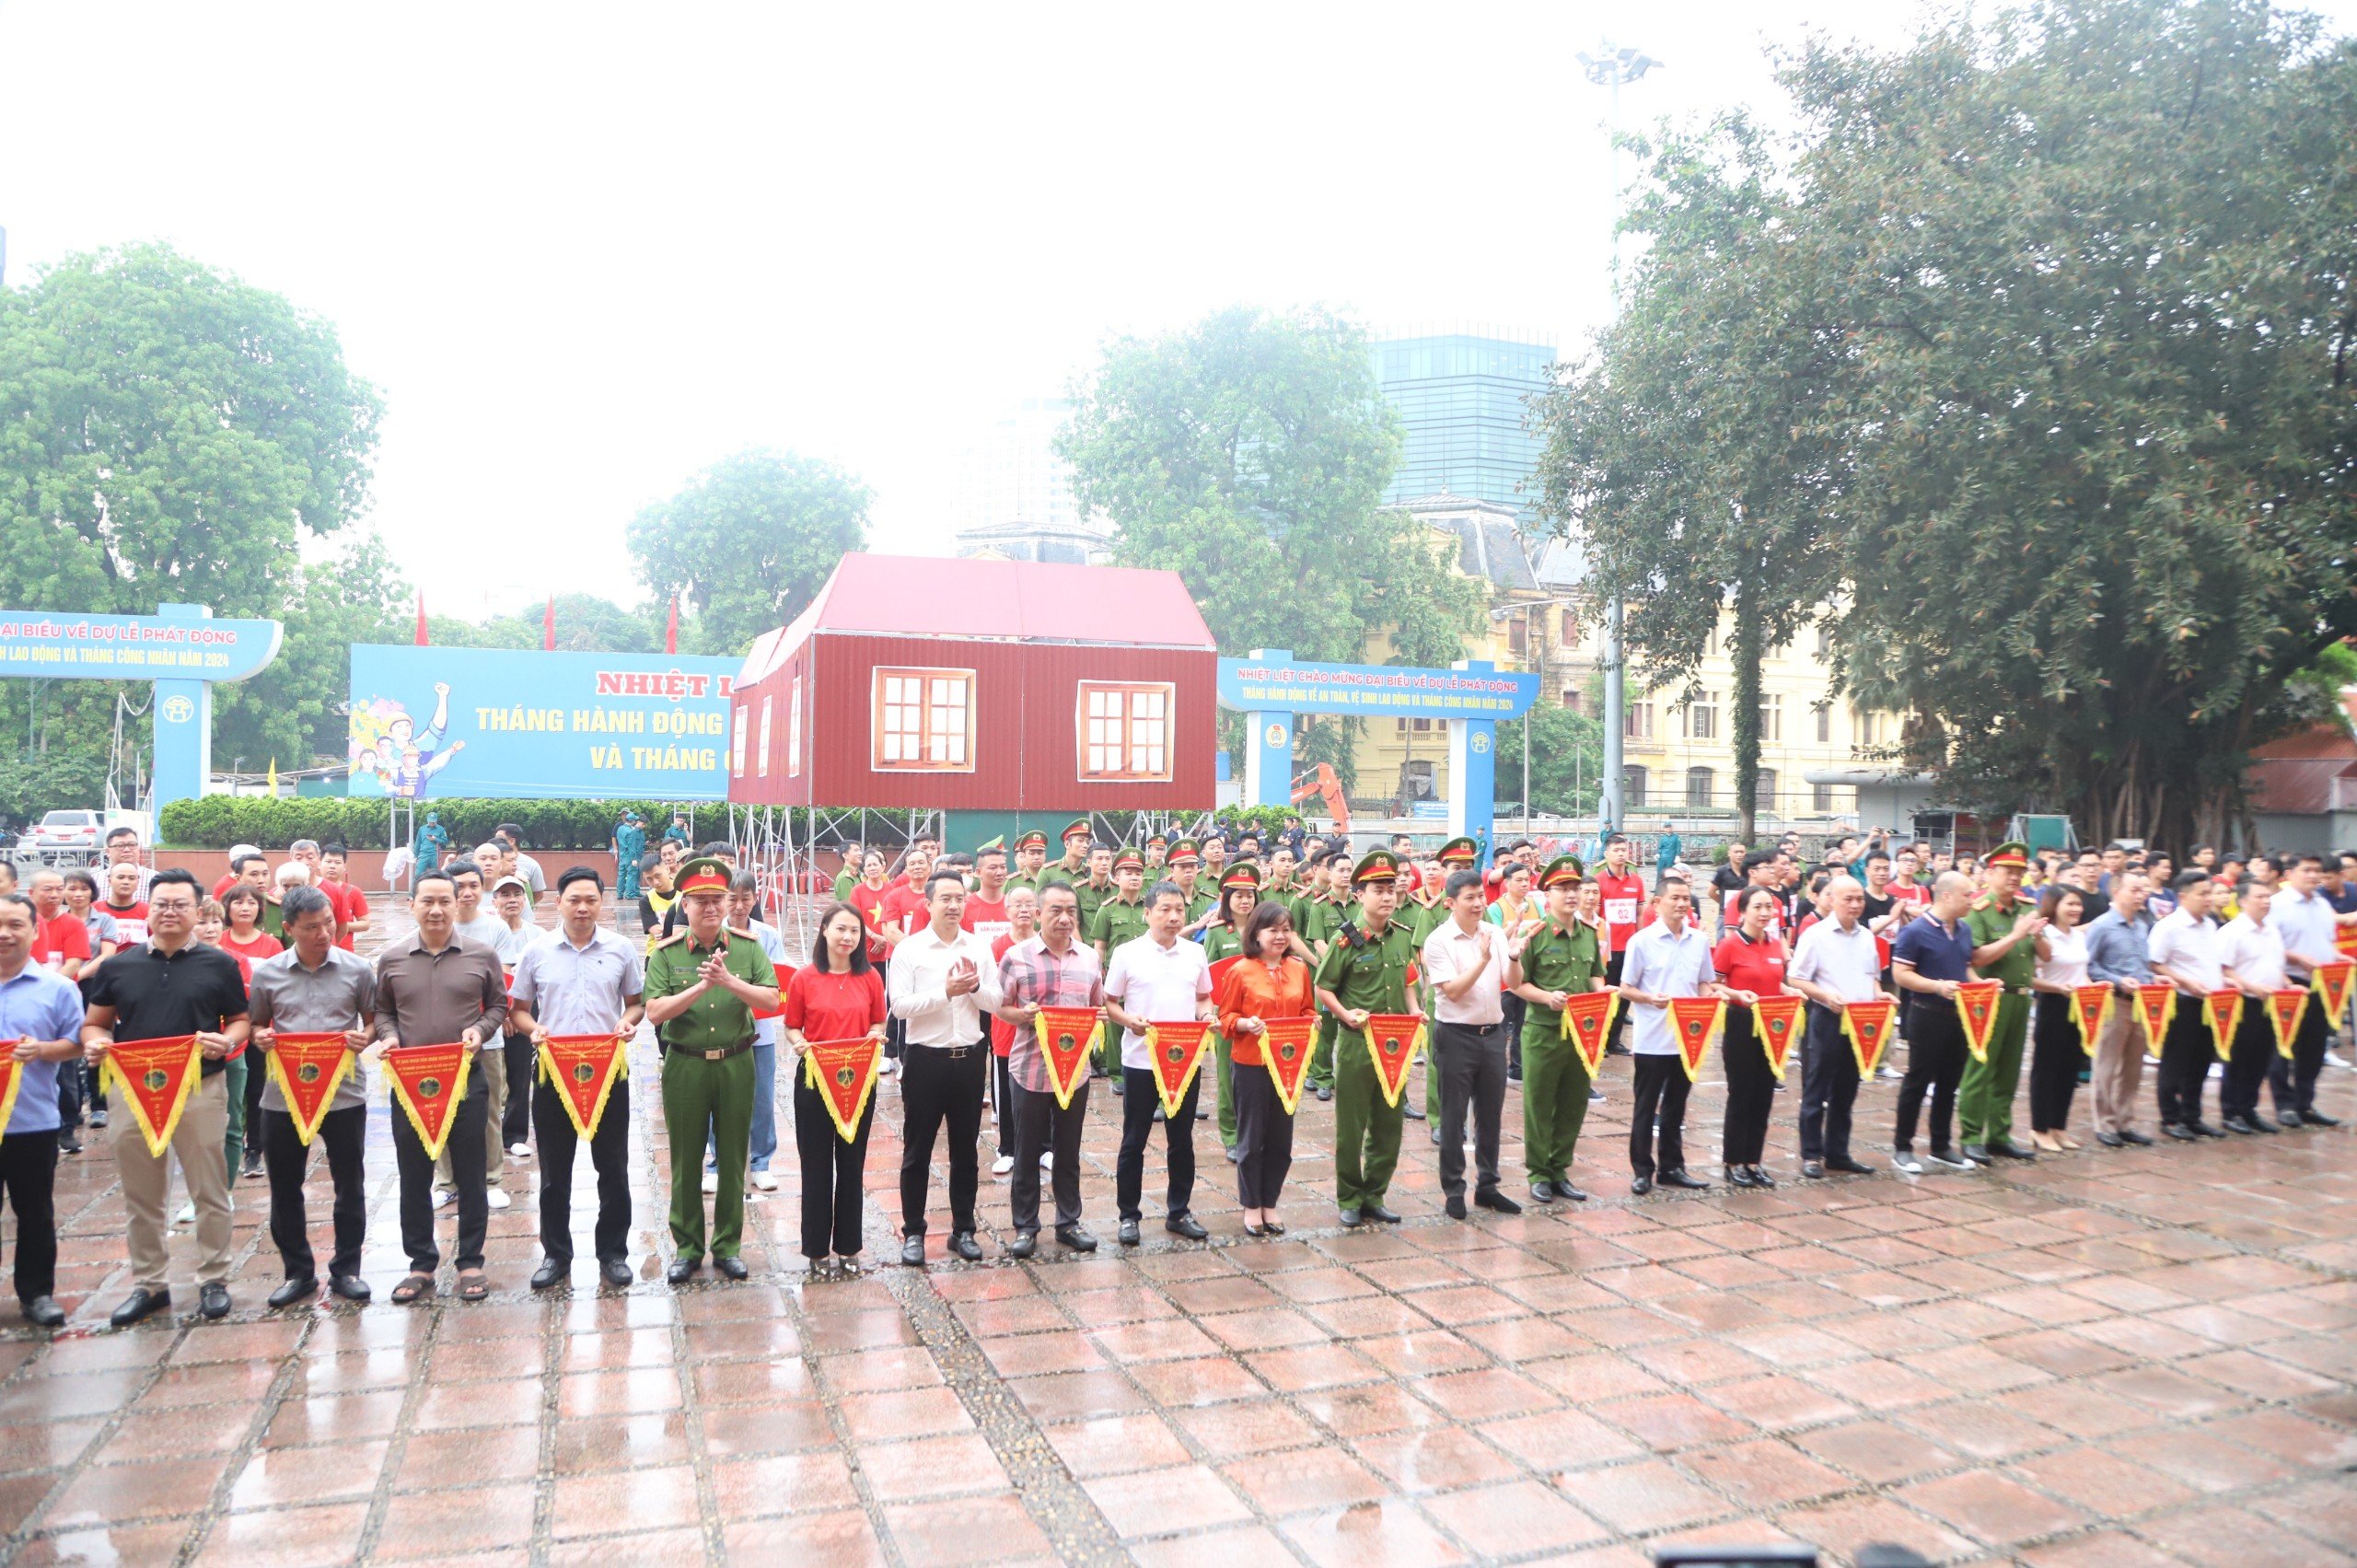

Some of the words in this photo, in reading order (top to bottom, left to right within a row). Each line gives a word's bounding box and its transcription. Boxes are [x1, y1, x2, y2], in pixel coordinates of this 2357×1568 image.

[23, 620, 62, 637] BIỂU
[66, 621, 87, 639] VỀ
[91, 624, 118, 643] DỰ
[120, 621, 139, 641] LỄ
[143, 625, 186, 643] PHÁT
[190, 627, 237, 647] ĐỘNG
[9, 646, 29, 661] LAO
[32, 645, 61, 664] ĐỘNG
[64, 645, 77, 662] VÀ
[80, 645, 114, 663] THÁNG
[117, 646, 145, 664] CÔNG
[147, 648, 177, 666] NHÂN
[179, 649, 203, 667] NĂM
[205, 653, 229, 667] 2024
[597, 668, 709, 702] NHIỆT
[1237, 667, 1270, 683] NHIỆT
[1273, 668, 1295, 684] LIỆT
[1298, 669, 1329, 683] CHÀO
[1331, 670, 1363, 685] MỪNG
[1365, 674, 1384, 689] ĐẠI
[1387, 672, 1411, 688] BIỂU
[1413, 674, 1427, 688] VỀ
[1429, 677, 1445, 691] DỰ
[1446, 675, 1458, 690] LỄ
[1460, 678, 1487, 691] PHÁT
[1489, 679, 1517, 694] ĐỘNG
[1242, 685, 1265, 699] THÁNG
[1267, 686, 1286, 700] HÀNH
[1288, 687, 1306, 703] ĐỘNG
[1318, 691, 1328, 702] AN
[1362, 692, 1377, 704] SINH
[1378, 692, 1390, 704] LAO
[1392, 691, 1410, 707] ĐỘNG
[1422, 693, 1442, 706] THÁNG
[1445, 694, 1461, 707] CÔNG
[1463, 695, 1480, 709] NHÂN
[1498, 699, 1514, 710] 2024
[476, 704, 564, 733] THÁNG
[573, 705, 644, 734] HÀNH
[653, 707, 723, 739] ĐỘNG
[589, 742, 623, 770] VÀ
[631, 743, 716, 772] THÁNG
[1618, 909, 1629, 919] 02
